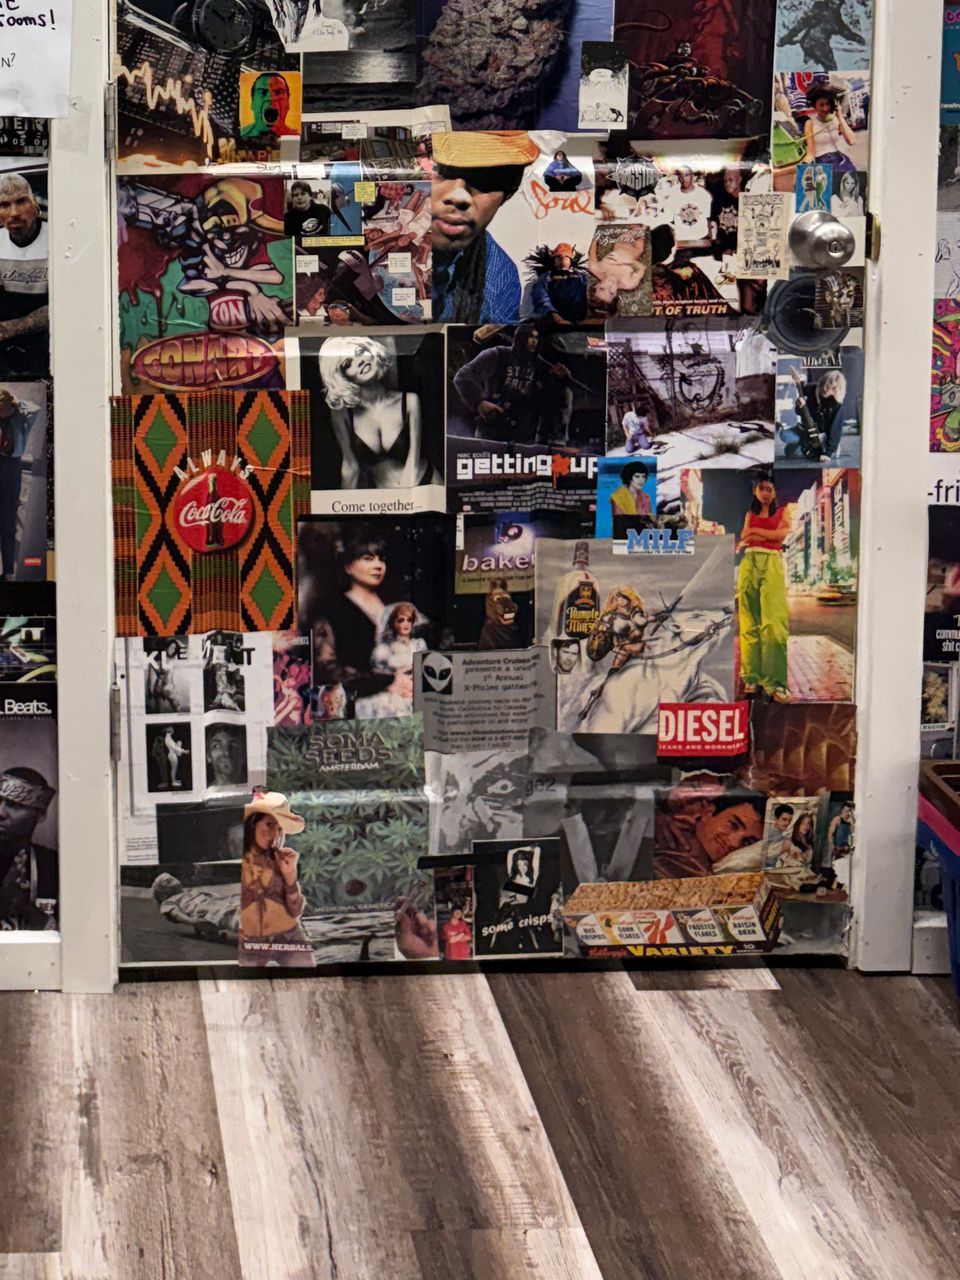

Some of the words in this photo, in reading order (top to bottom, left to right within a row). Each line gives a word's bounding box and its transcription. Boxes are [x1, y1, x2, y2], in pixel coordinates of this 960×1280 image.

[666, 306, 681, 315] OF
[685, 304, 727, 315] TRUTH
[174, 449, 253, 481] ALWAYS
[457, 453, 551, 479] getting
[332, 500, 365, 513] Come
[626, 528, 694, 550] MILF
[566, 606, 600, 622] Rumple
[462, 658, 501, 666] Adventure
[659, 708, 744, 742] DIESEL
[309, 732, 386, 750] SOMA
[304, 747, 392, 764] SEEDS
[319, 762, 379, 773] AMSTERDAM
[482, 922, 513, 937] some
[519, 912, 554, 929] crisps
[688, 923, 717, 931] FROSTED
[732, 921, 757, 929] RAISIN
[626, 945, 734, 958] VARIETY
